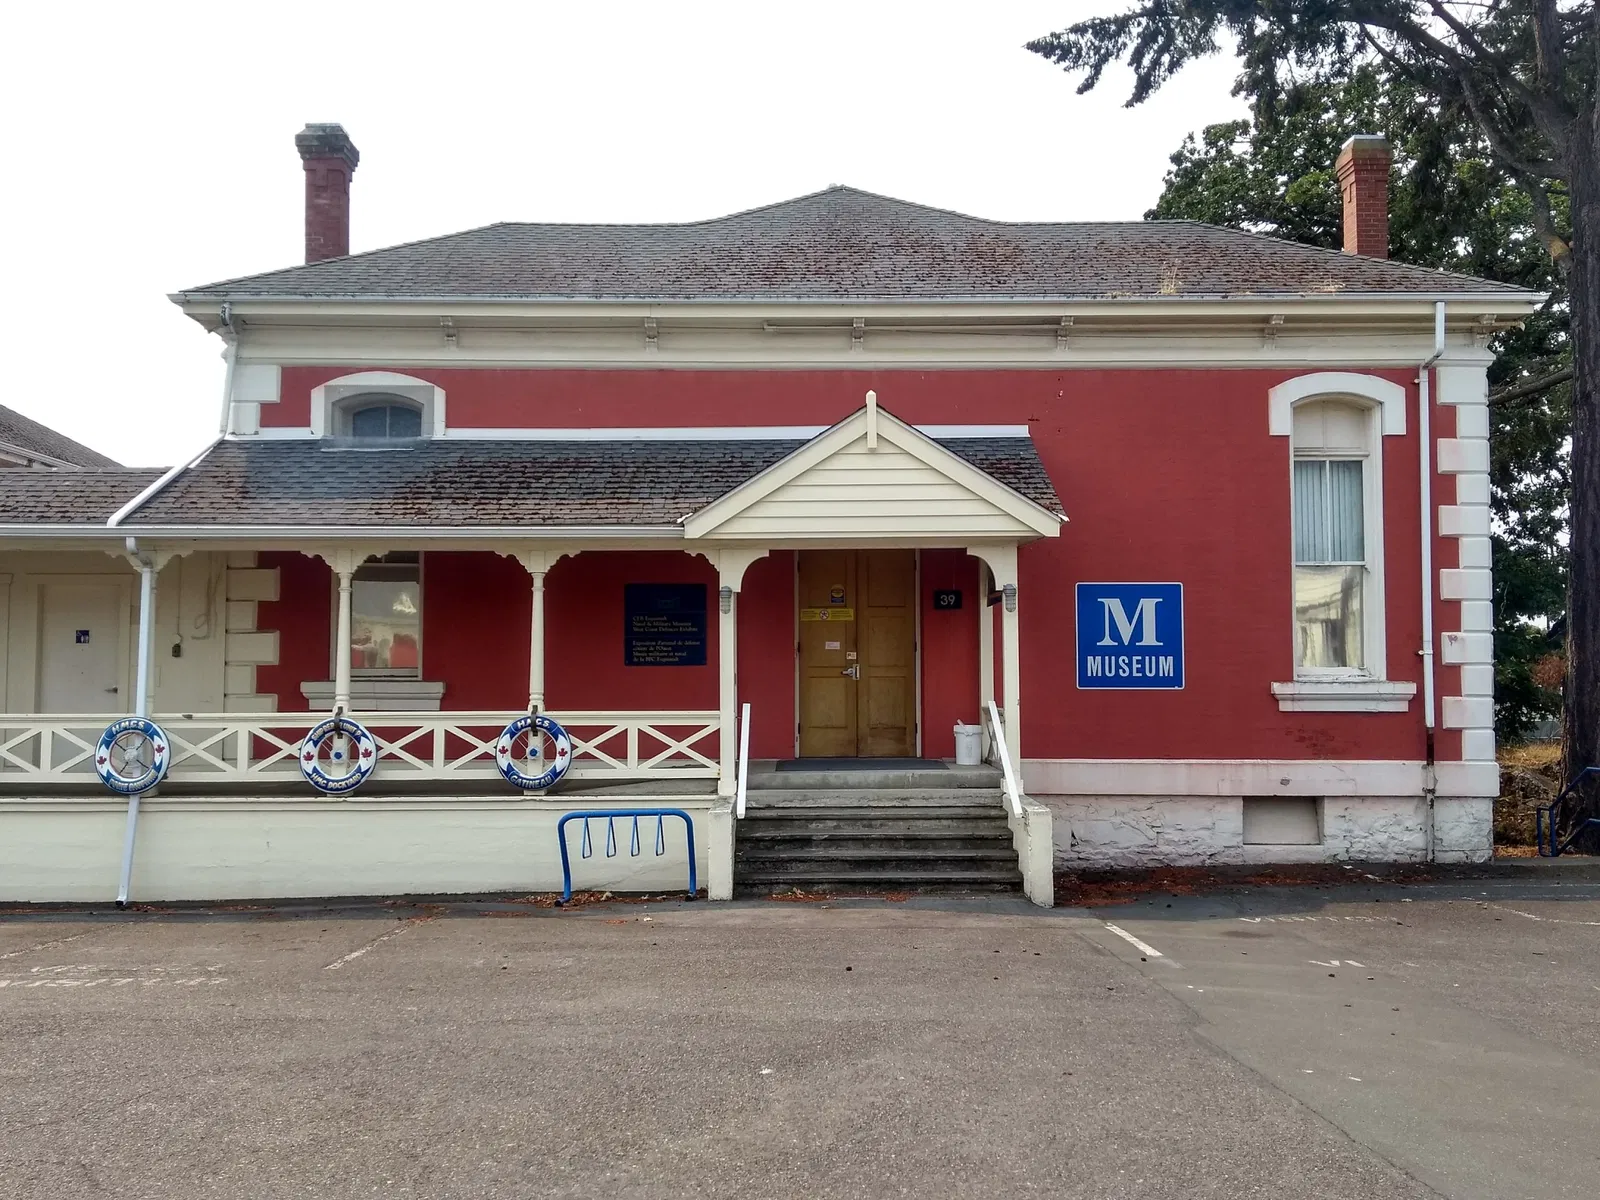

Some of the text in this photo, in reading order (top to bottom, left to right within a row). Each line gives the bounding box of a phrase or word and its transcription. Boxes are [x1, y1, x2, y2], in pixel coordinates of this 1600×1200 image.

[940, 594, 956, 606] 39
[1097, 598, 1163, 646] M
[1087, 656, 1174, 677] MUSEUM
[327, 773, 362, 789] DOCKYARD
[510, 775, 552, 788] GATINEAU
